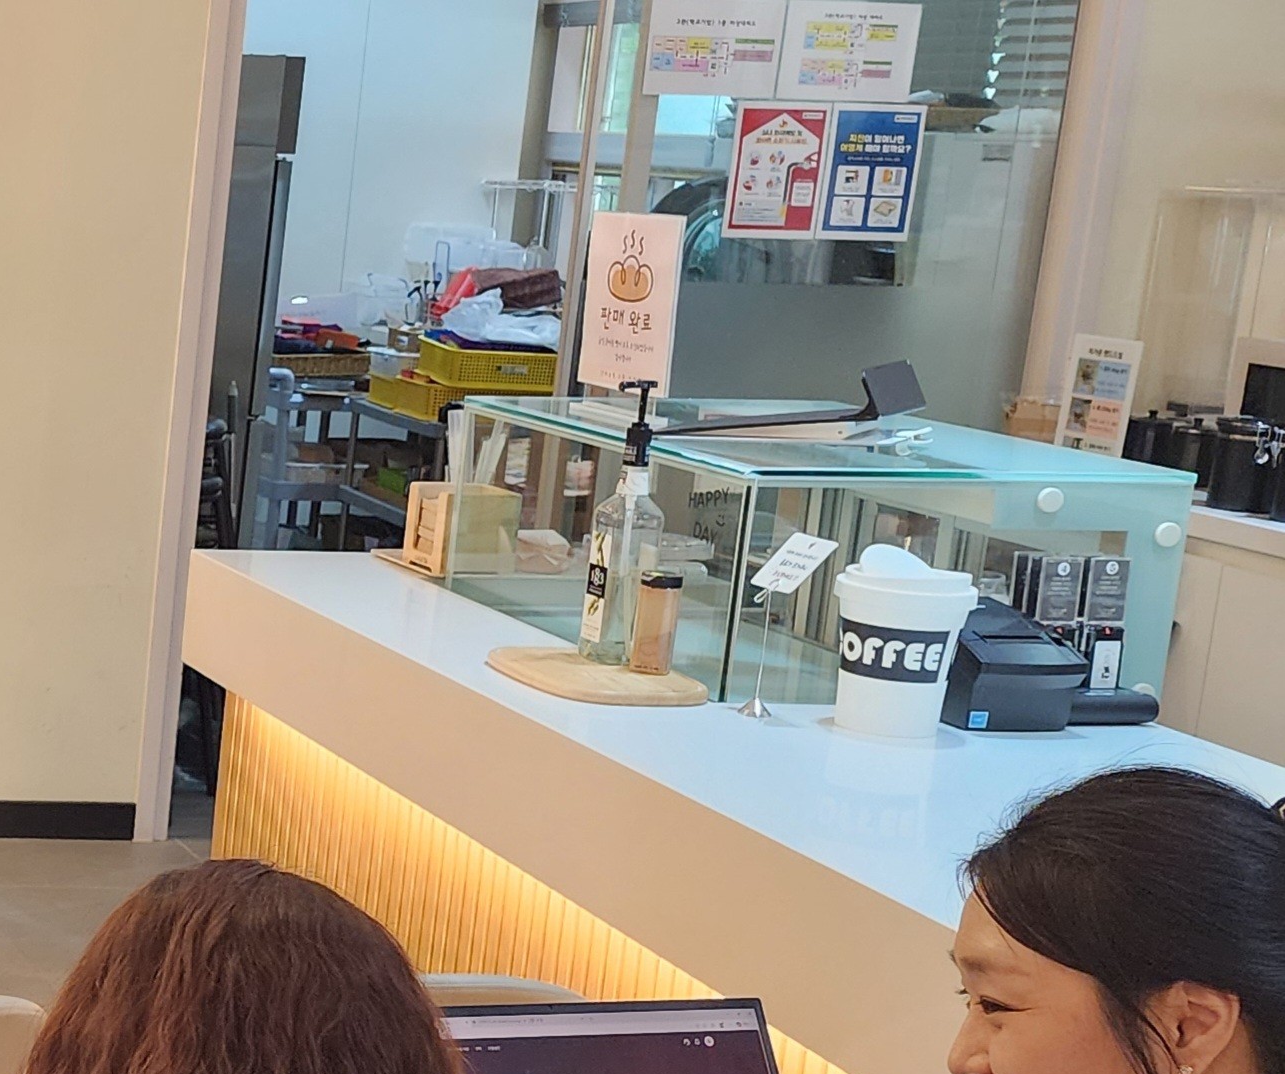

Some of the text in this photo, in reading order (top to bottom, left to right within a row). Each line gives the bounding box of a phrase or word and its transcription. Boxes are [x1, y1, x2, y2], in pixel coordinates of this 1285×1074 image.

[601, 307, 652, 335] 판매 완료
[688, 487, 730, 508] HAPPY
[692, 520, 719, 546] DAY
[841, 630, 923, 672] OFFEE
